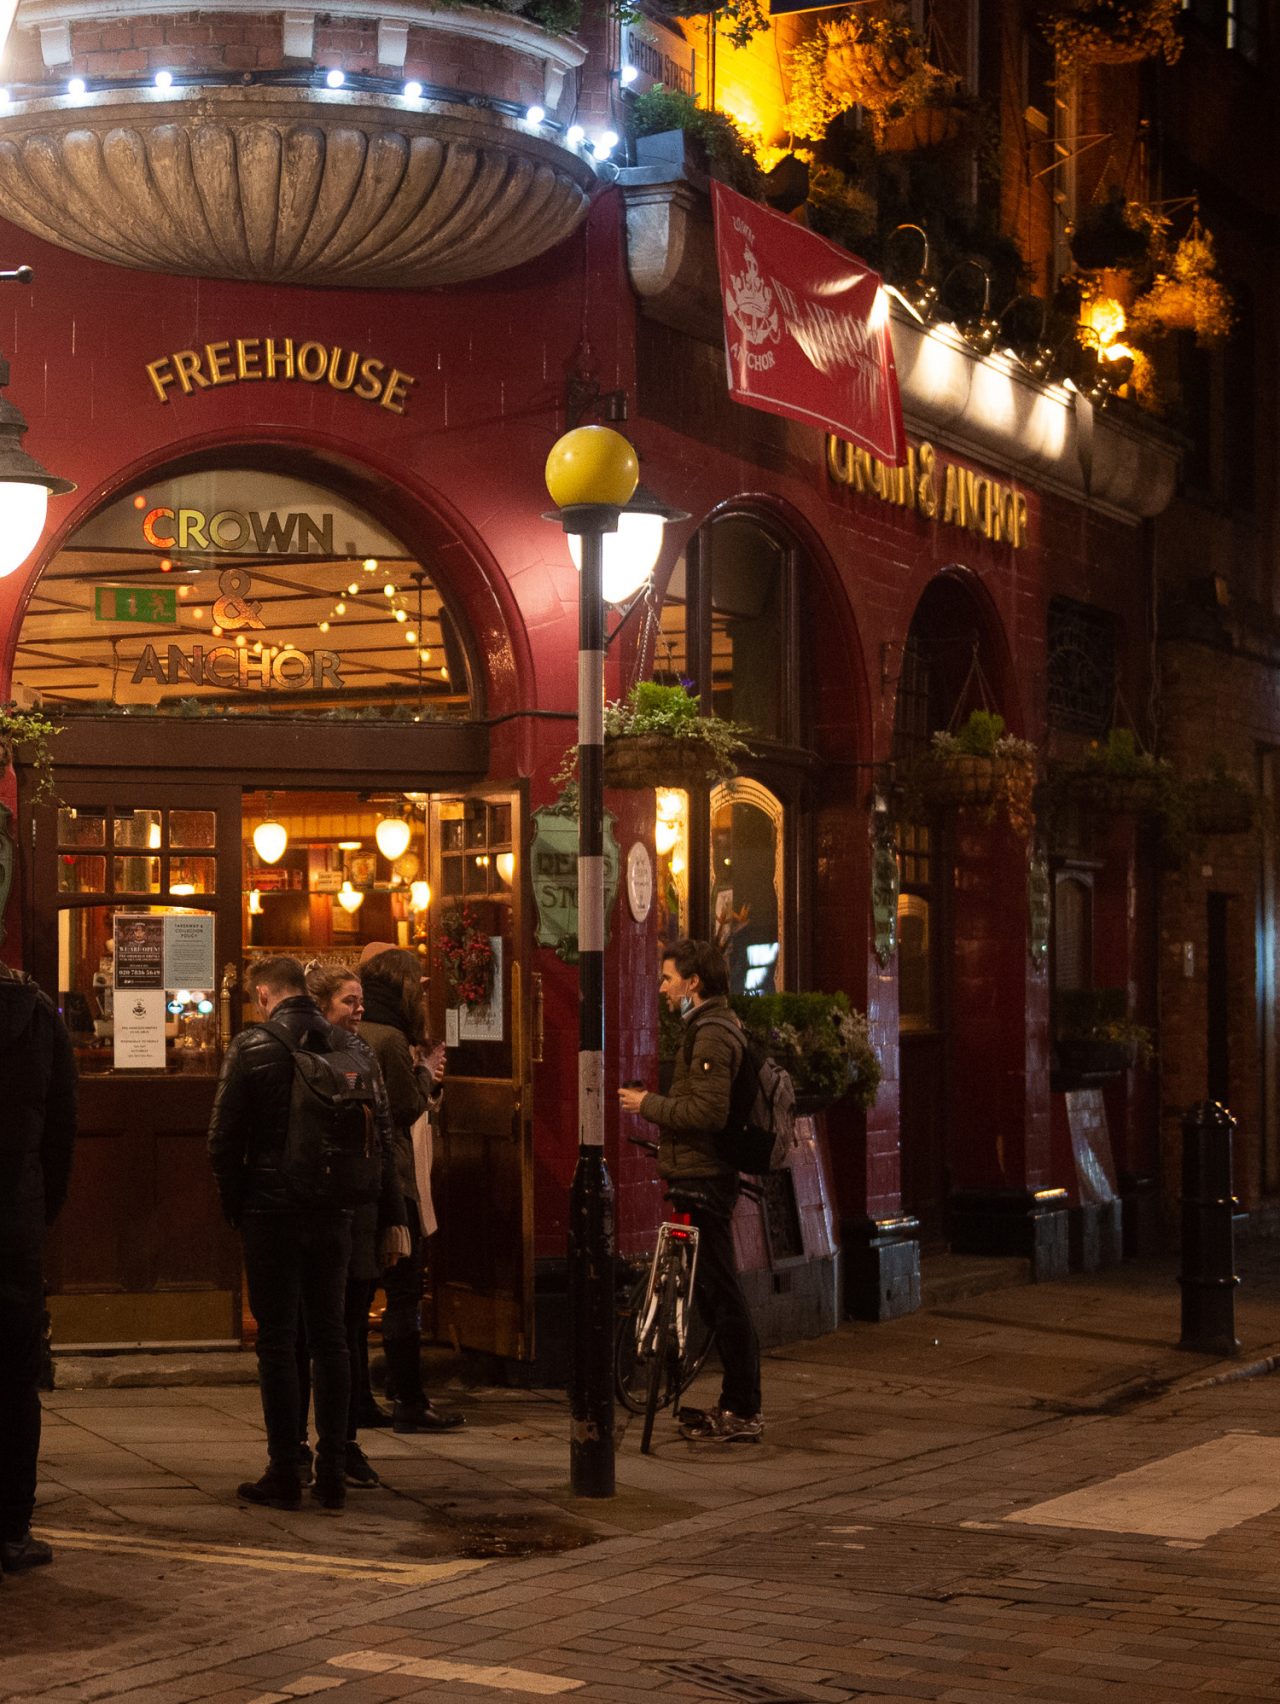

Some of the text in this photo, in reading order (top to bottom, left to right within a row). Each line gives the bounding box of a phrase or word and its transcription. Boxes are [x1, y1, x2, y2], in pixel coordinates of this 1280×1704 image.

[145, 337, 415, 415] FREEHOUSE
[730, 343, 776, 372] ANCHOR
[142, 507, 334, 553] CROWN
[943, 463, 1028, 549] ANCHOR
[211, 568, 266, 630] &
[131, 644, 345, 689] ANCHOR
